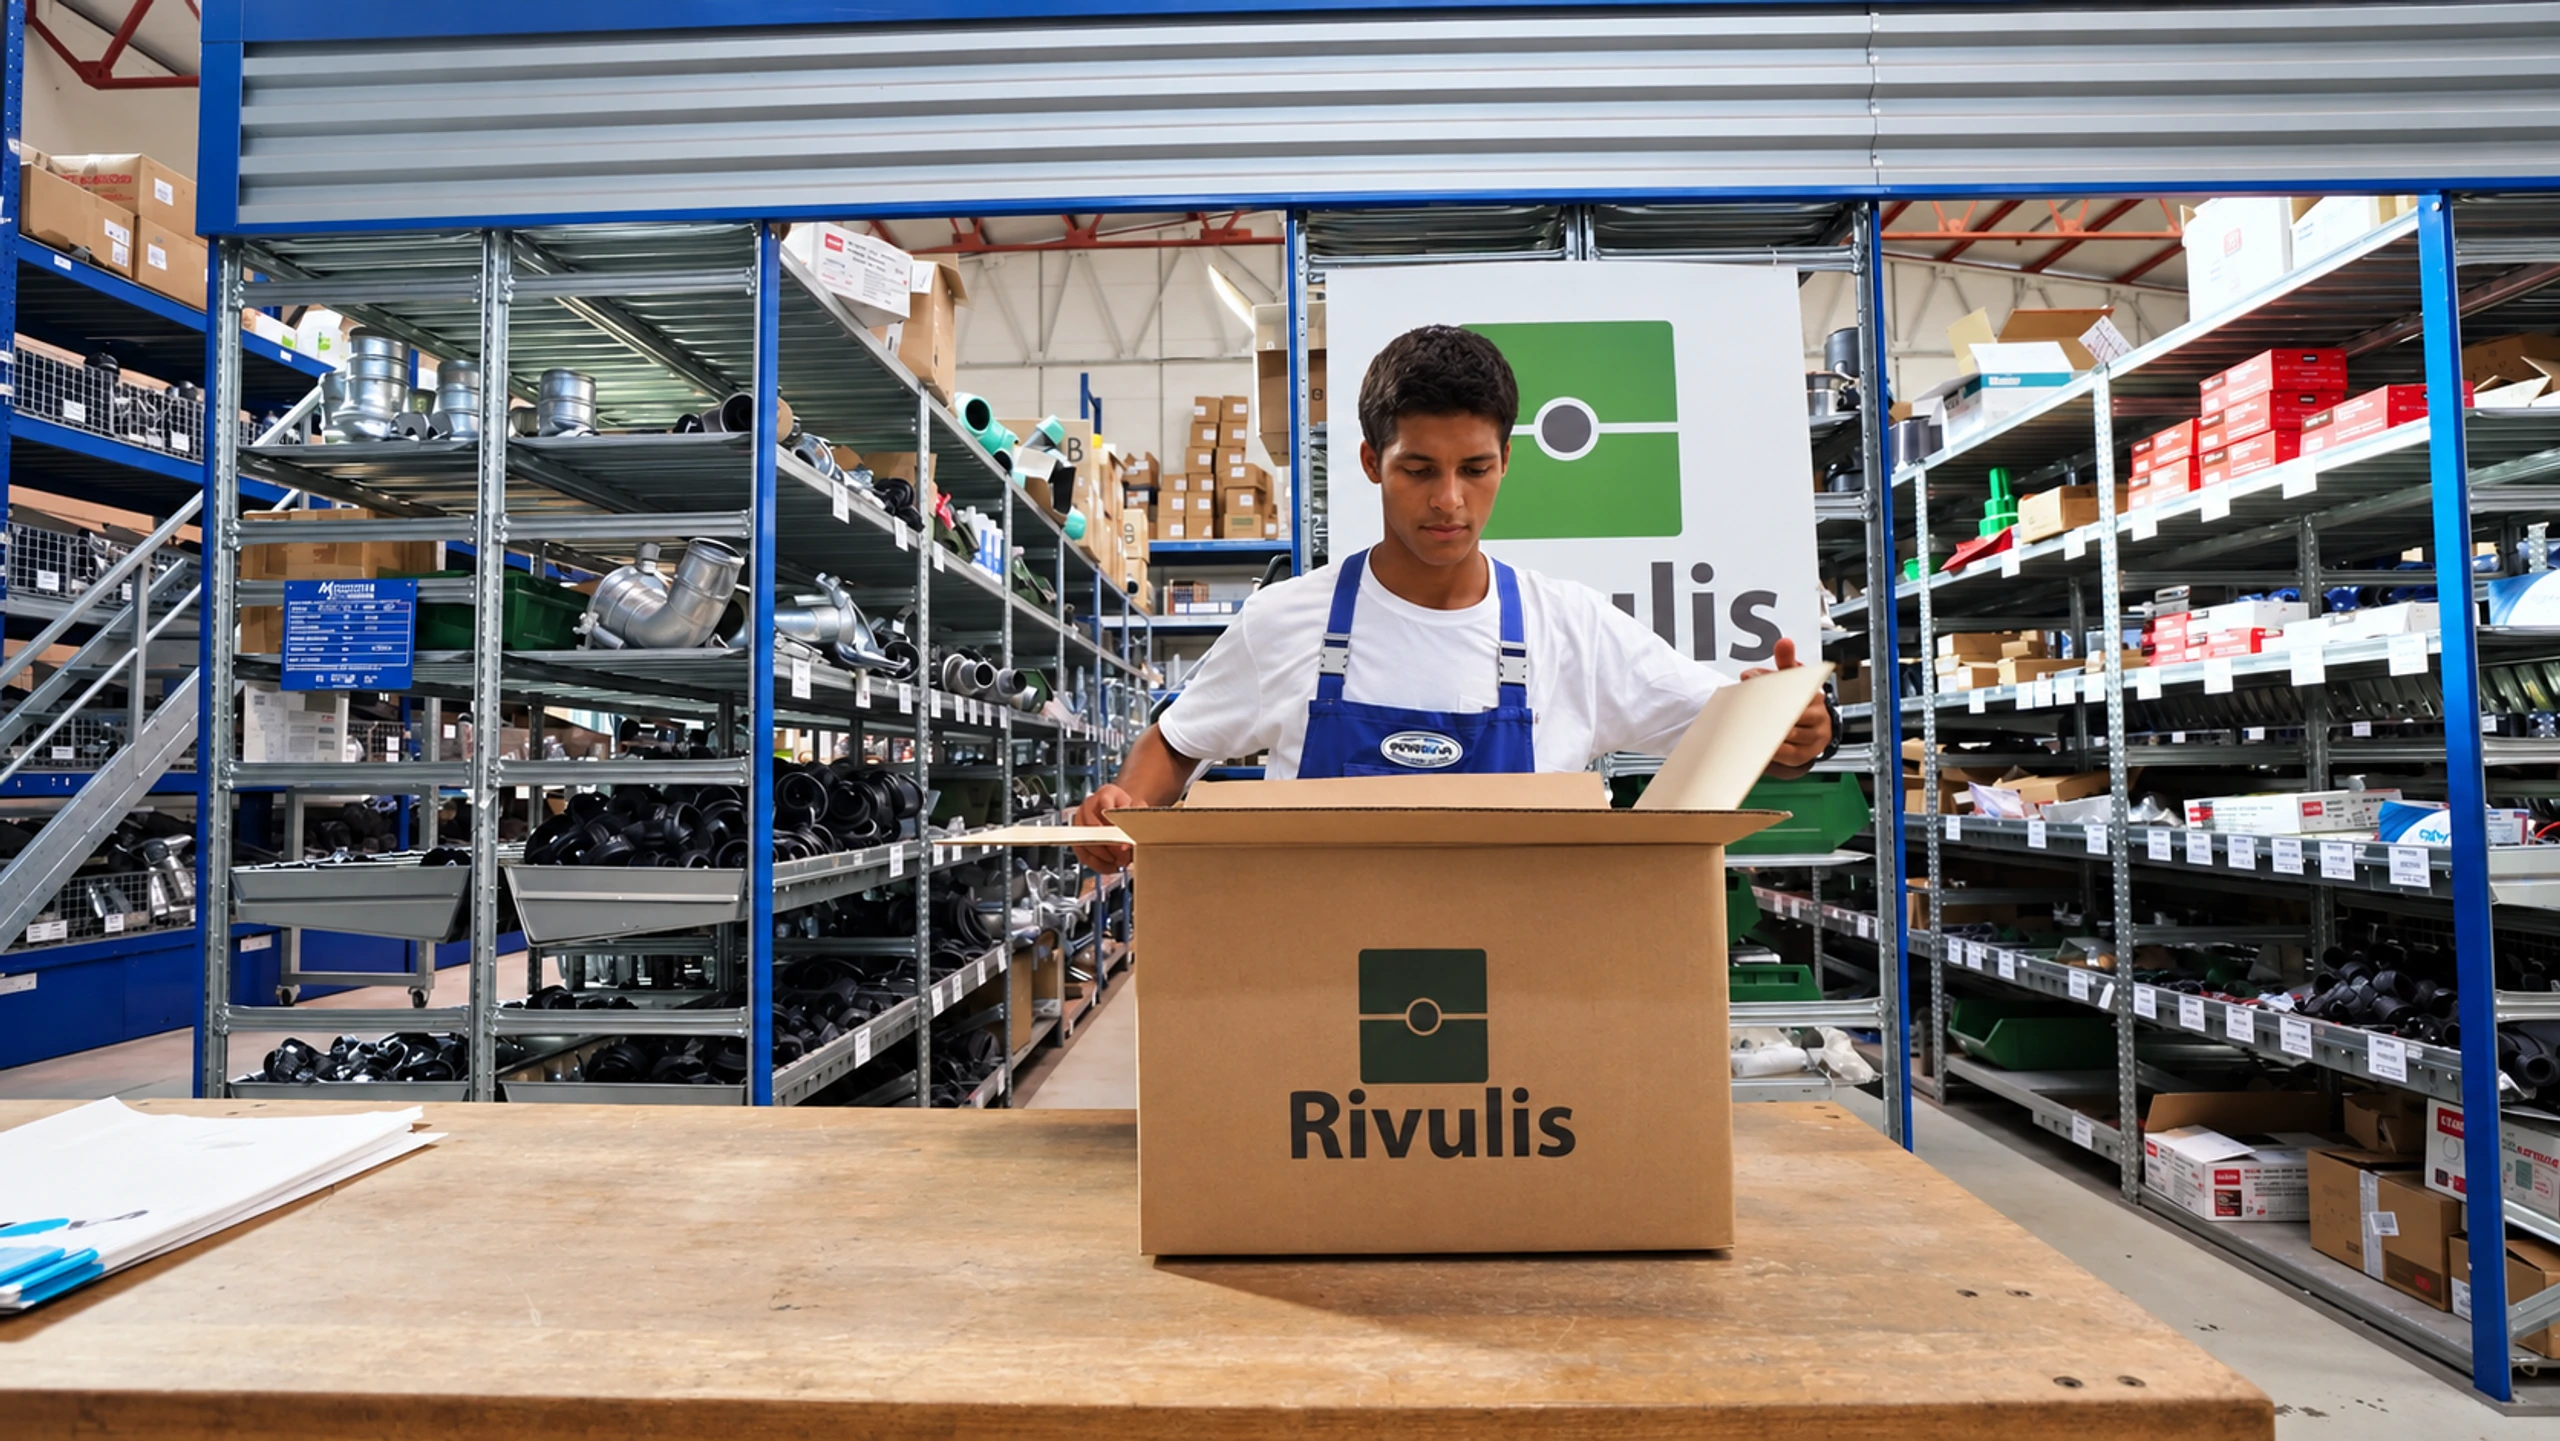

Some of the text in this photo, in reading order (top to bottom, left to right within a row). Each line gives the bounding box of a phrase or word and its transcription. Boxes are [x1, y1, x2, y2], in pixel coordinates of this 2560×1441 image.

[1067, 437, 1084, 463] B
[1612, 561, 1782, 662] lis
[1290, 1087, 1577, 1160] Rivulis
